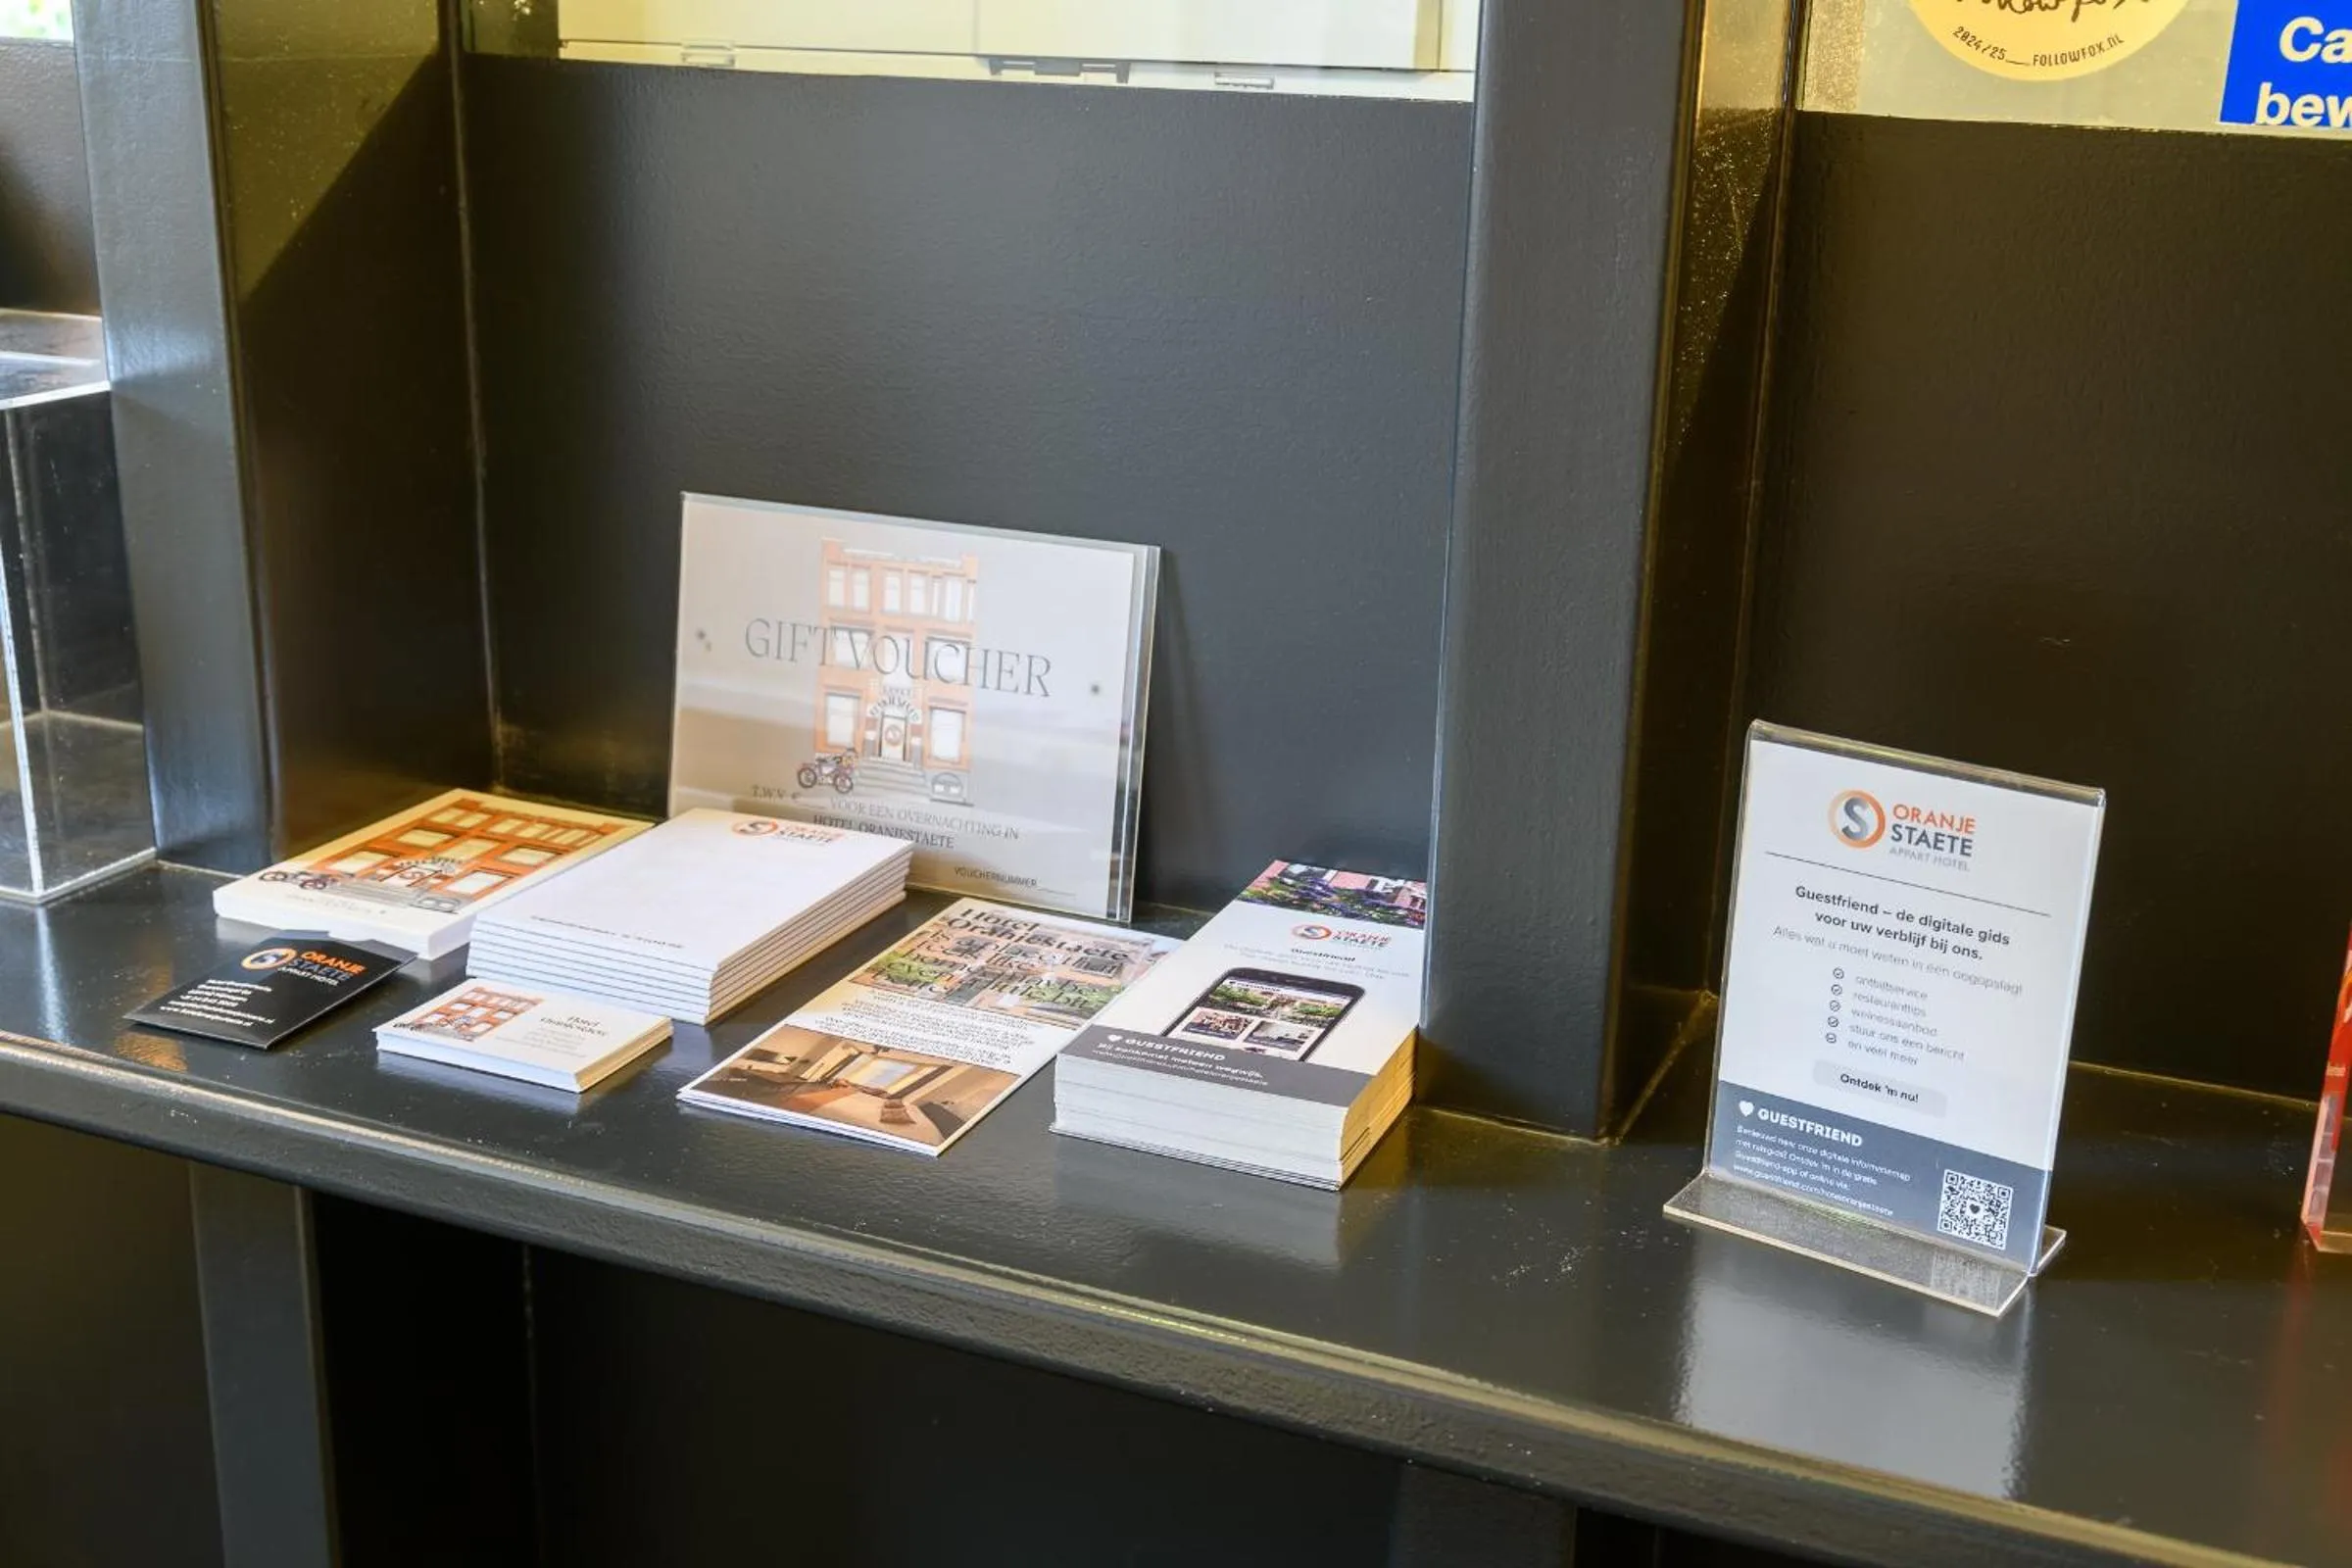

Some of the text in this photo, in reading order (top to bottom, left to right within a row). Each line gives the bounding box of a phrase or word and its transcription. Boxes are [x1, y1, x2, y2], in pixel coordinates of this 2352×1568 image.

[745, 617, 1052, 699] GIFT VOUCHER
[869, 804, 894, 819] EEN
[897, 808, 1002, 838] OVERNACHTING
[1892, 803, 1975, 834] ORANJE
[1890, 823, 1973, 857] STAETE
[960, 907, 1043, 933] Hotel
[1795, 885, 1878, 915] Guestfriend
[1896, 908, 1915, 923] de
[1918, 913, 1973, 940] digitale
[1977, 927, 2009, 948] gids
[948, 917, 1130, 961] Oranjestaete
[1774, 924, 1801, 940] Alles
[1804, 933, 1825, 946] wat
[1838, 941, 1868, 956] moet
[1871, 950, 1908, 966] weten
[1815, 910, 1982, 960] voor uw verblijf bij ons.
[300, 952, 367, 974] ORANJE
[1125, 1038, 1225, 1061] GUESTFRIEND
[1840, 1073, 1880, 1092] Ontdek
[1900, 1090, 1918, 1102] nu!
[1757, 1107, 1863, 1147] GUESTFRIEND
